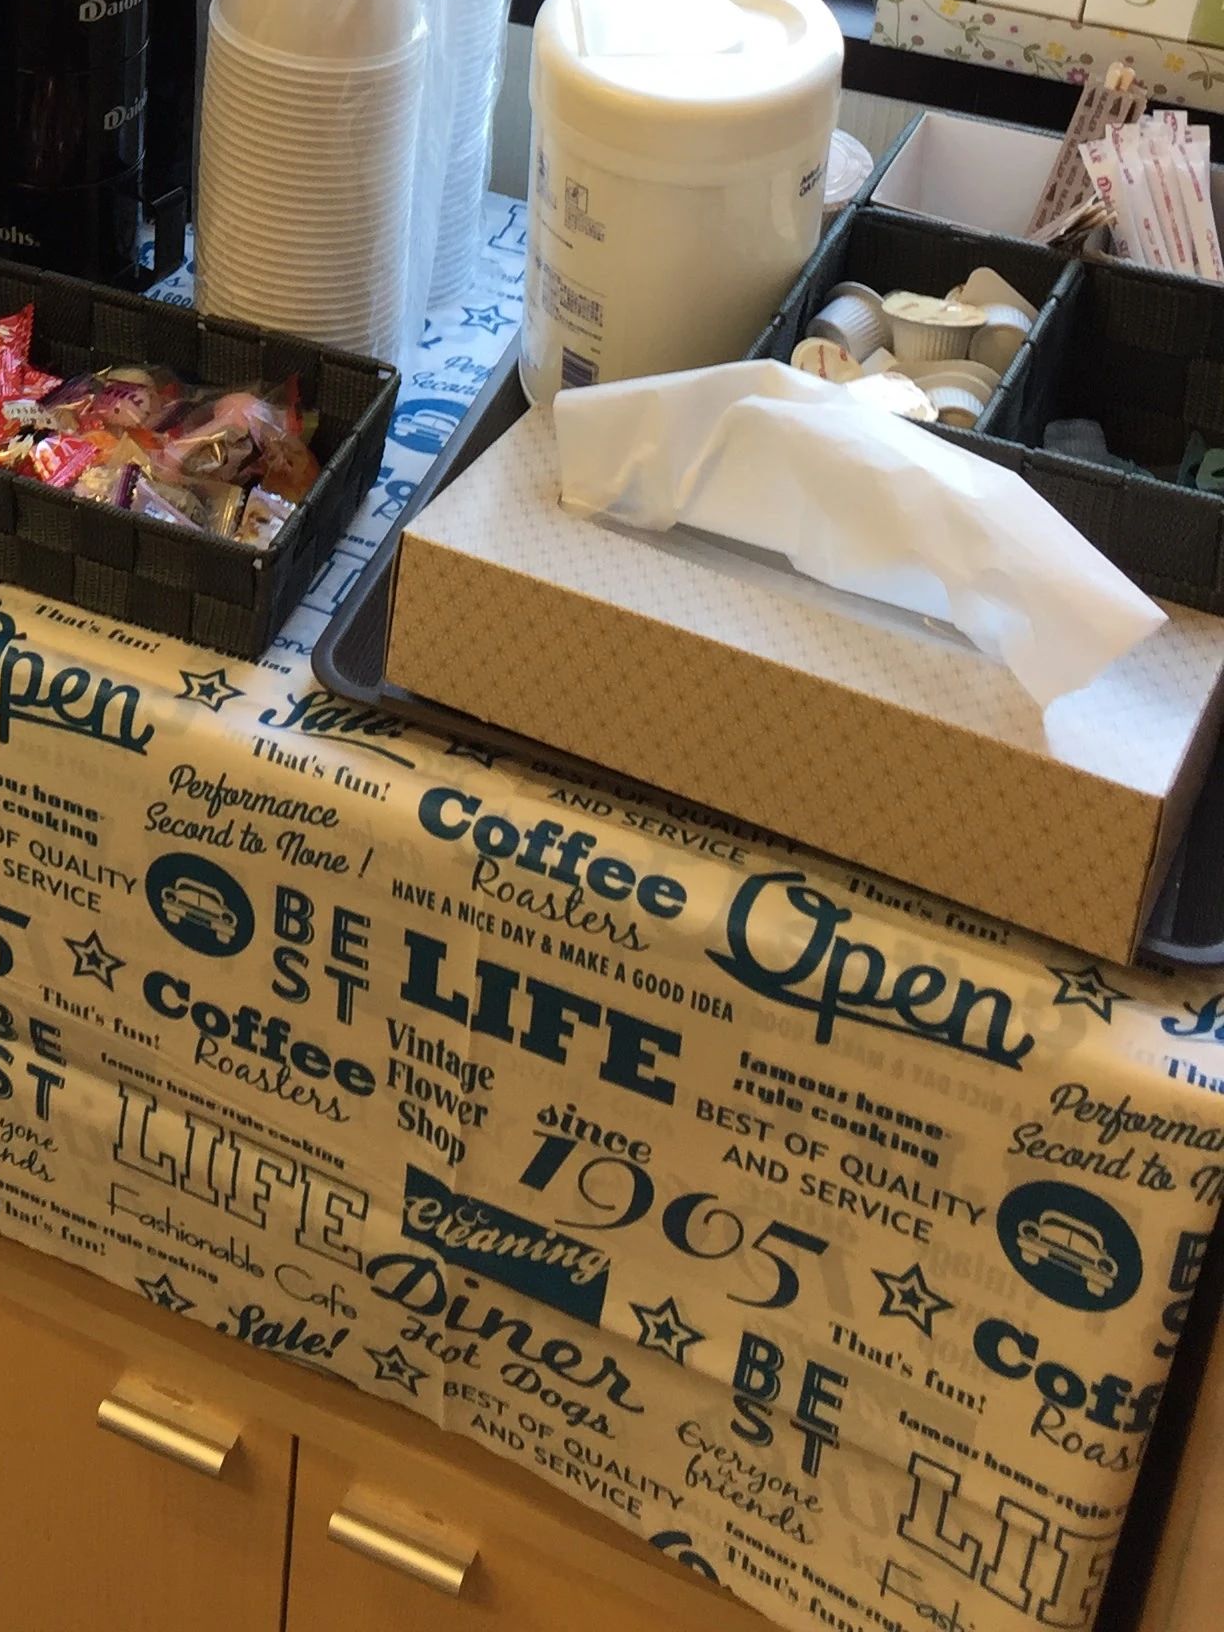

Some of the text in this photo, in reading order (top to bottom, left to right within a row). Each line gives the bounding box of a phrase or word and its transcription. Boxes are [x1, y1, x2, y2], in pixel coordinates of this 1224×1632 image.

[35, 605, 160, 653] That's fun!
[169, 765, 339, 828] Performance
[253, 738, 390, 801] That's fun!
[3, 795, 98, 848] cooking
[29, 825, 137, 900] QUALITY
[144, 800, 234, 851] Second
[416, 787, 687, 925] Coffee
[547, 788, 752, 866] AND SERVICE
[3, 855, 101, 913] SERVICE
[472, 855, 650, 953] Roasters
[392, 878, 732, 1023] HAVE NICE DAY MAKE GOOD IDEA
[704, 871, 1035, 1072] Open
[39, 985, 159, 1050] That's fun!
[143, 965, 376, 1098] Coffee
[386, 1017, 494, 1096] Vintage
[400, 925, 684, 1106] LIFE
[194, 1032, 350, 1123] Roasters
[387, 1057, 494, 1131] Flower
[740, 1051, 848, 1106] famous
[398, 1100, 472, 1168] Shop
[537, 1104, 651, 1164] since
[696, 1098, 986, 1226] BEST OF QUALITY
[809, 1092, 943, 1168] cooking
[1007, 1123, 1132, 1185] Second
[1135, 1153, 1177, 1191] to
[113, 1079, 369, 1272] LIFE
[722, 1145, 933, 1244] AND SERVICE
[106, 1181, 265, 1279] Fashionable
[519, 1128, 830, 1310] 1965
[216, 1304, 350, 1361] Sale!
[366, 1252, 644, 1415] Diner
[830, 1322, 986, 1414] That's fun!
[399, 1316, 616, 1441] Hot Dogs
[443, 1381, 684, 1510] BEST OF QUALITY
[471, 1414, 642, 1519] AND SERVICE
[677, 1420, 824, 1514] Everyone
[899, 1410, 979, 1460] famous
